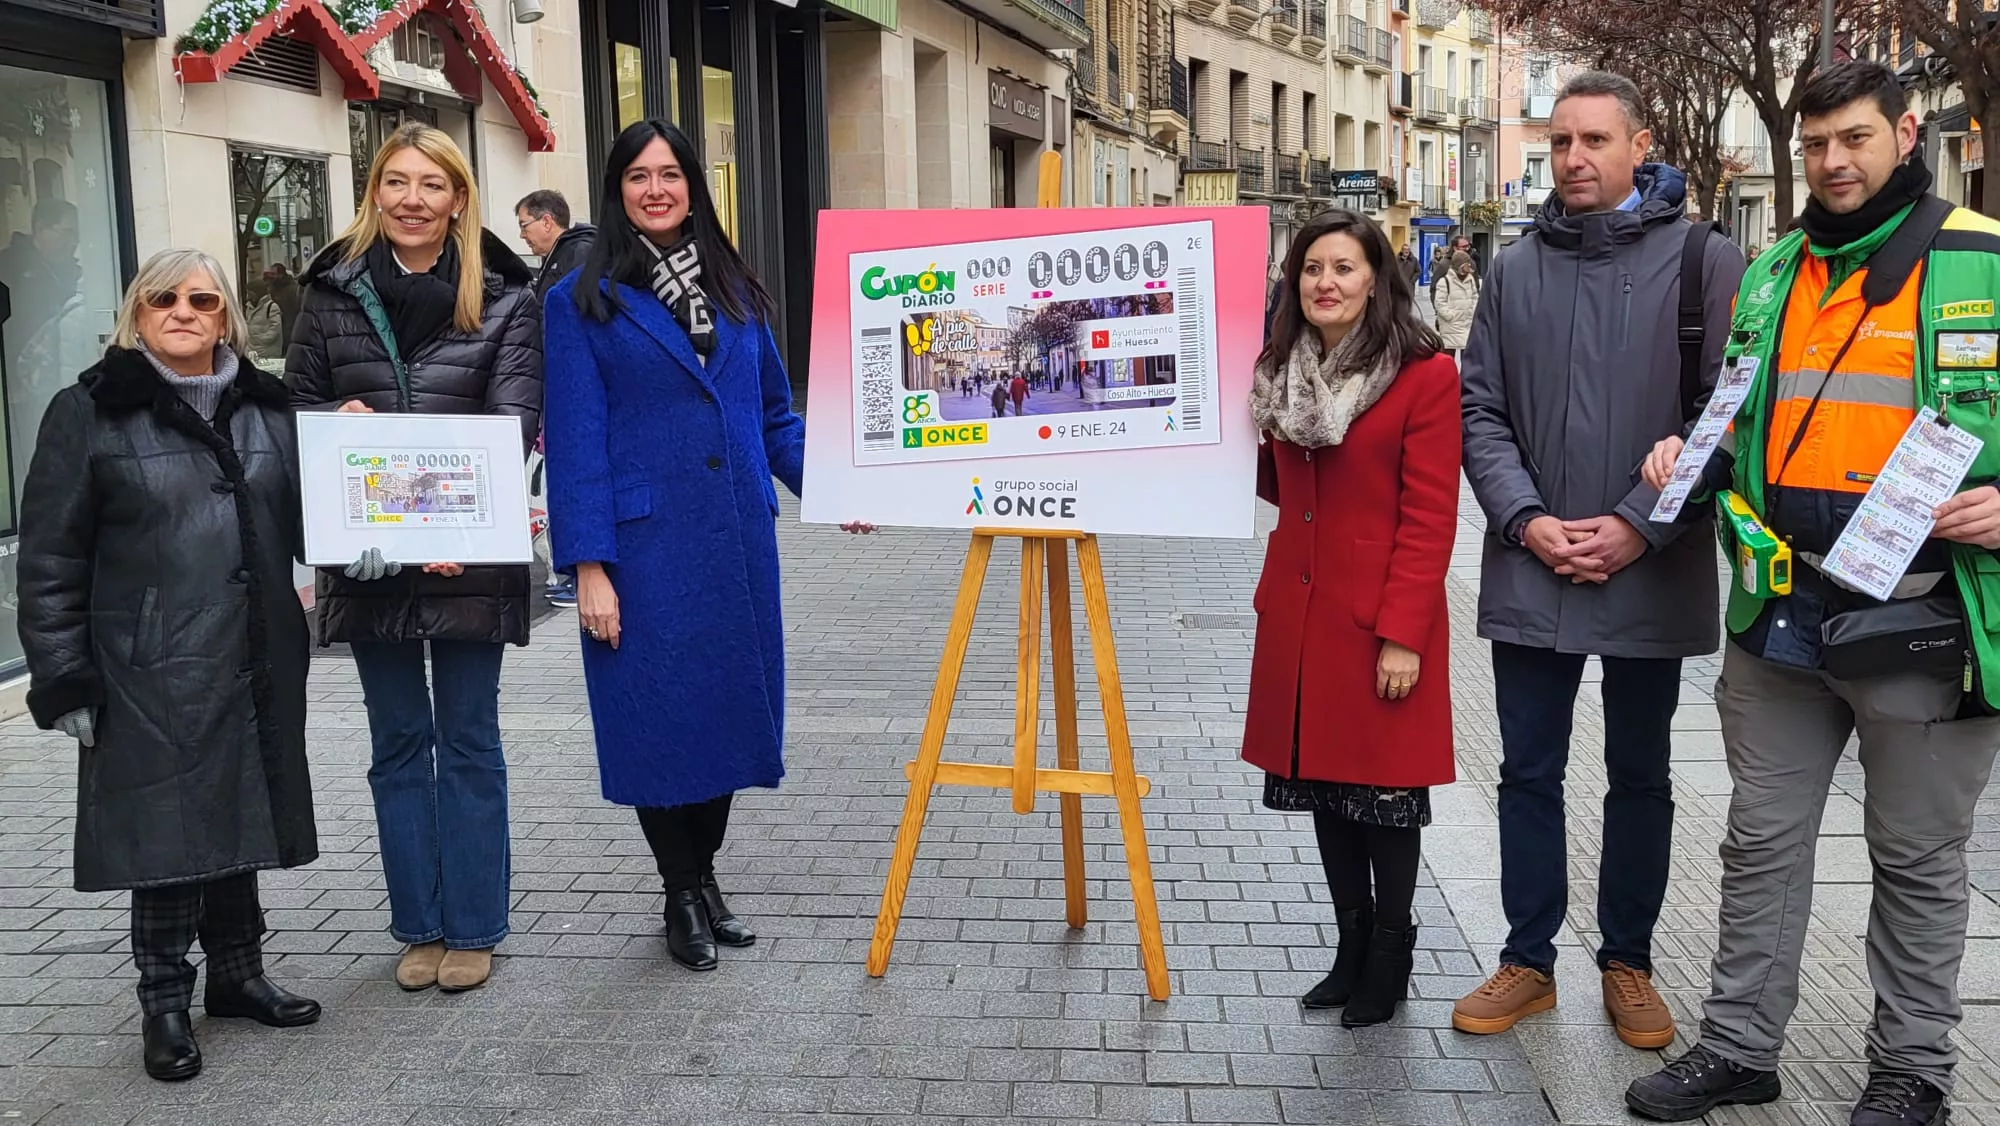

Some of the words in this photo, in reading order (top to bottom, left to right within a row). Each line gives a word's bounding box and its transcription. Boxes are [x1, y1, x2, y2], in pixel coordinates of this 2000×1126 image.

[1188, 175, 1233, 201] ASCASO
[1338, 177, 1376, 188] Arenas
[967, 256, 1011, 280] 000
[1028, 240, 1169, 289] 00000
[1187, 236, 1202, 250] 2€
[973, 282, 1006, 297] SERIE
[1947, 303, 1989, 315] ONCE
[930, 318, 942, 339] A
[946, 317, 966, 340] pie
[1112, 326, 1173, 338] Ayuntamiento
[931, 338, 947, 354] de
[948, 335, 978, 352] calle
[1112, 338, 1123, 348] de
[1125, 336, 1159, 347] Huesca
[1108, 390, 1125, 400] Coso
[1126, 388, 1142, 399] Alto
[1148, 386, 1175, 397] Huesca
[903, 393, 931, 424] 85
[927, 426, 983, 443] ONCE
[1057, 425, 1066, 438] 9
[1071, 423, 1106, 437] ENE.
[1109, 421, 1127, 435] 24
[416, 454, 472, 467] 00000
[994, 480, 1036, 492] grupo
[1039, 480, 1078, 492] social
[993, 495, 1077, 518] ONCE
